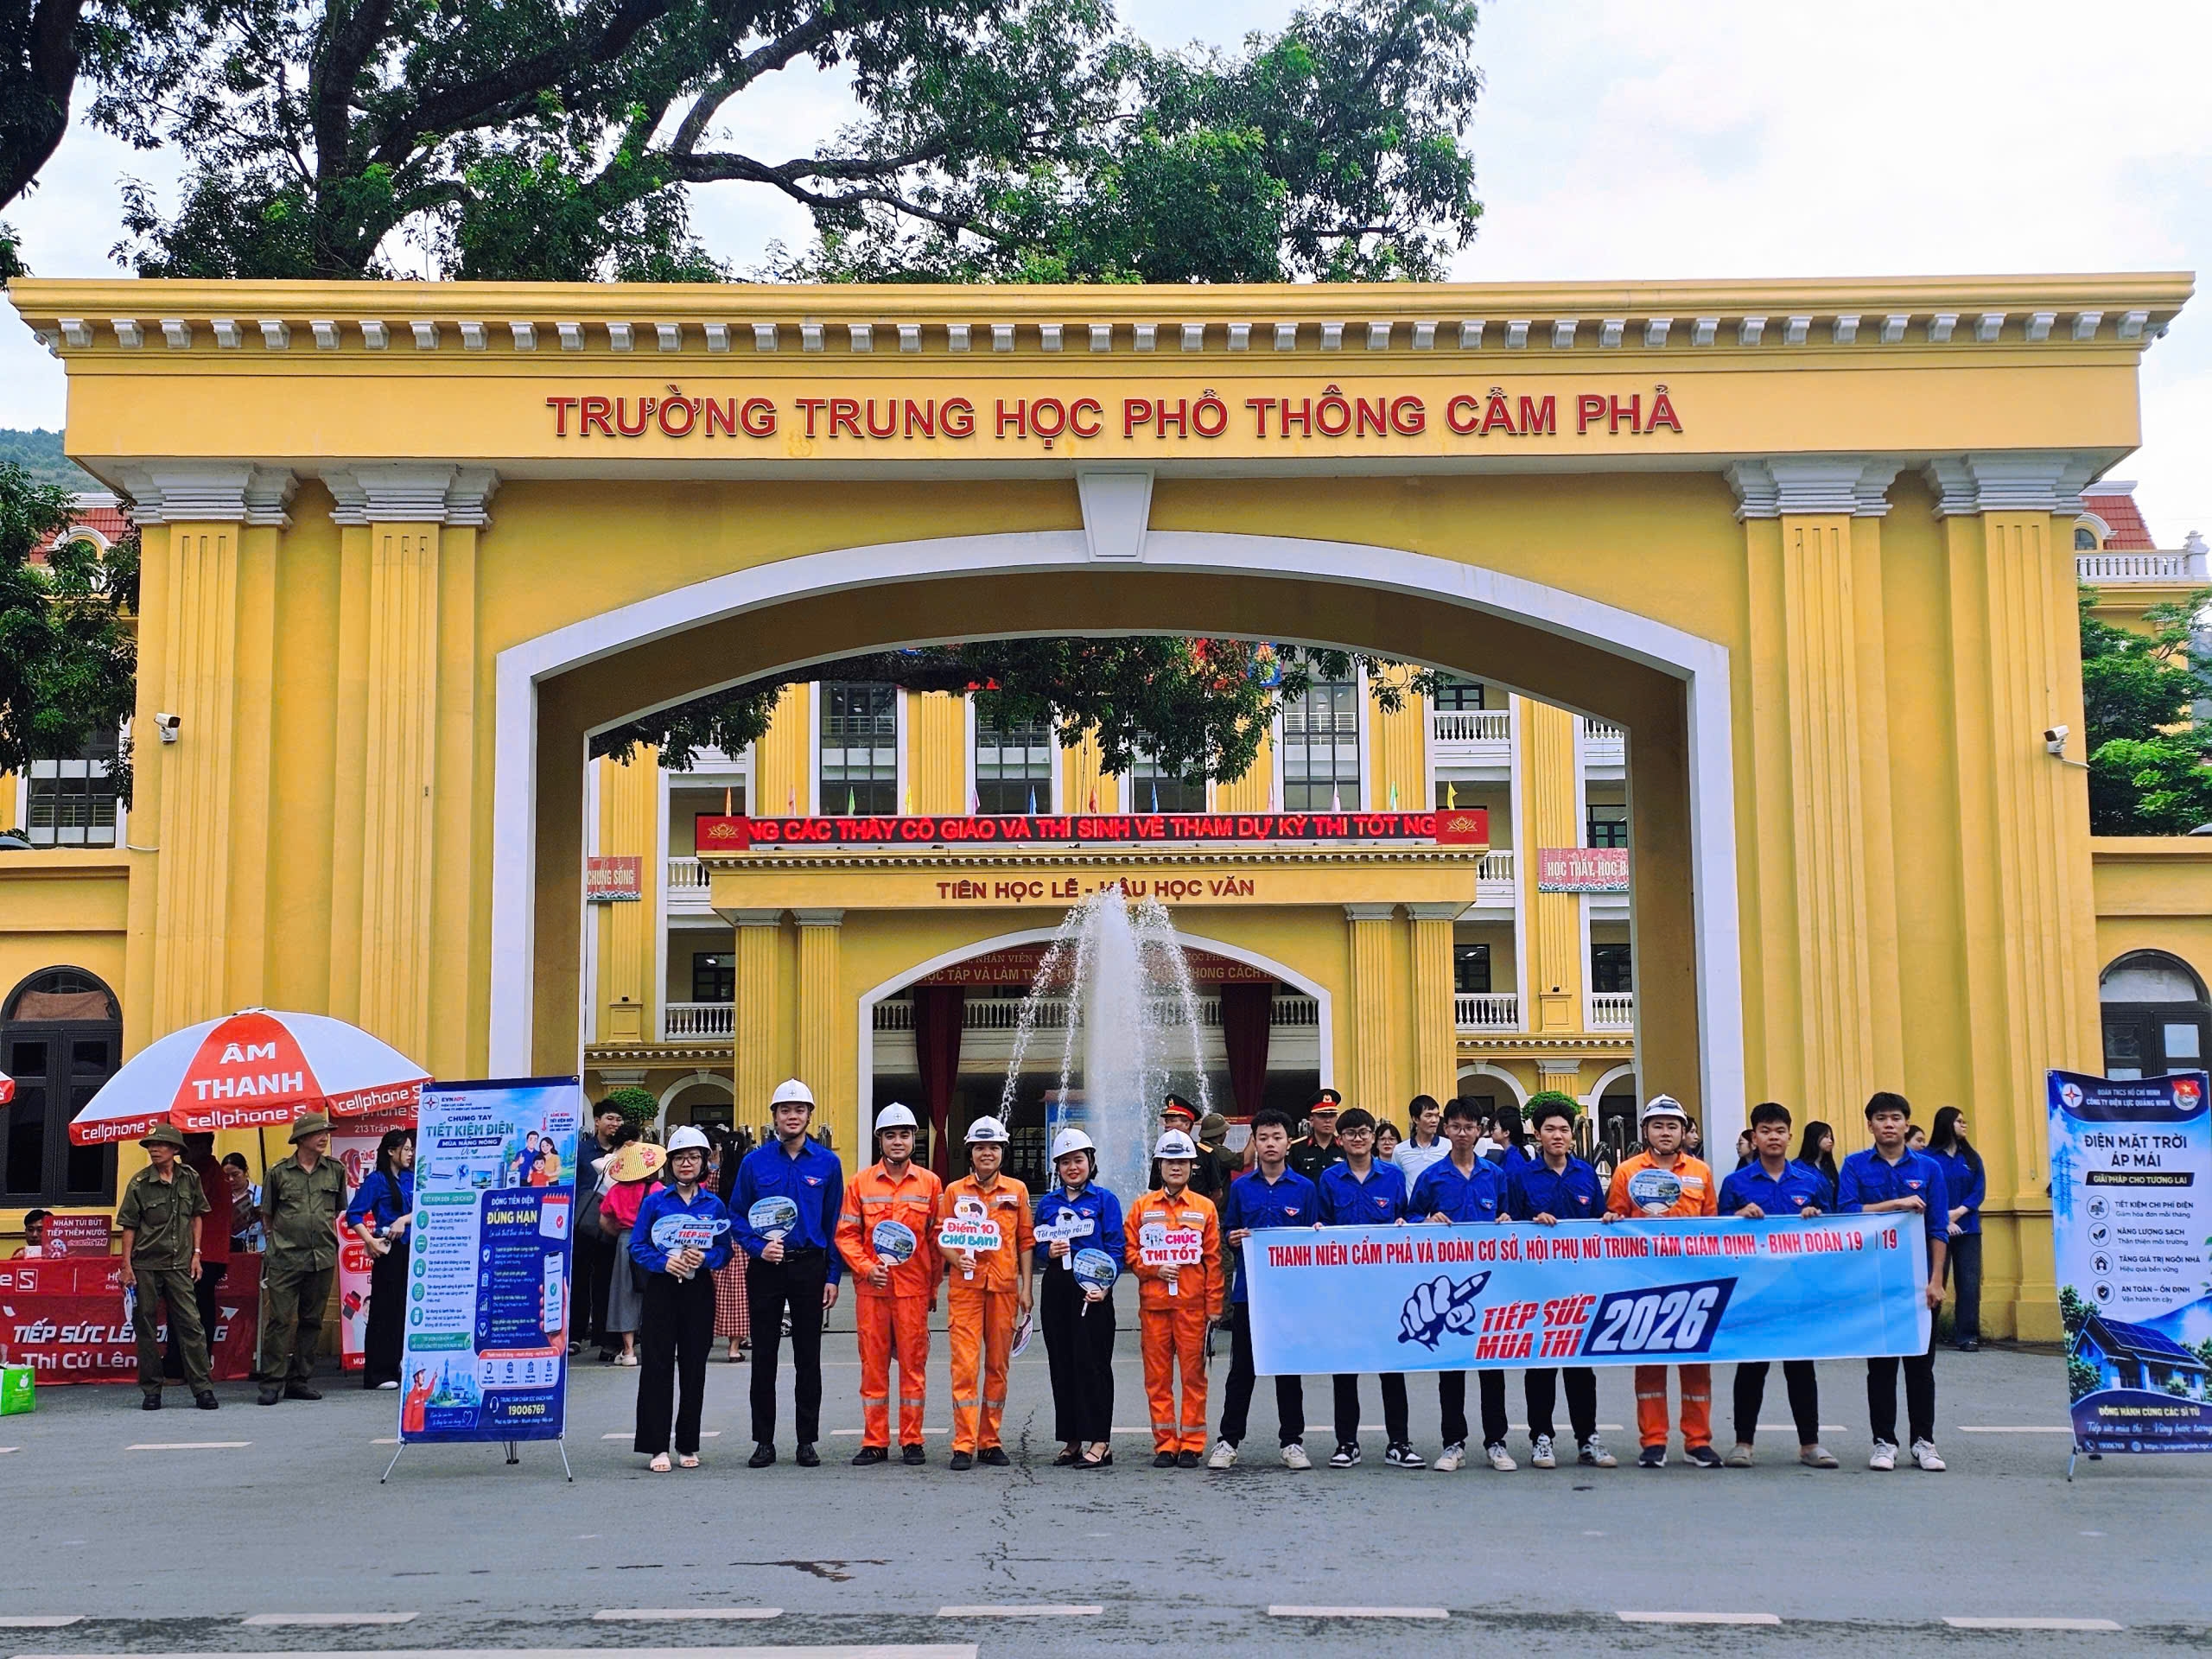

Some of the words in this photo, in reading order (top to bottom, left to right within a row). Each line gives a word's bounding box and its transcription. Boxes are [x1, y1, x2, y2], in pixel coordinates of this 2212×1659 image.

[546, 384, 778, 436] TRƯỜNG
[795, 397, 976, 437] TRUNG
[995, 397, 1103, 448] HỌC
[1123, 388, 1229, 436] PHỔ
[1246, 385, 1427, 436] THÔNG
[1445, 386, 1556, 435] CẨM
[1577, 385, 1683, 434] PHẢ
[784, 817, 831, 841] CÁC
[836, 817, 896, 841] THẦY
[901, 817, 935, 841] CÔ
[941, 817, 995, 839] GIÁO
[1001, 817, 1032, 838] VÀ
[1037, 817, 1071, 838] THÍ
[1077, 818, 1129, 839] SINH
[1135, 816, 1166, 838] VỀ
[1170, 818, 1231, 837] THAM
[1239, 817, 1272, 839] DỰ
[1313, 817, 1347, 836] THI
[613, 864, 633, 885] SỐNG
[1547, 861, 1567, 880] HỌC
[1598, 861, 1618, 880] HỌC
[995, 880, 1044, 902] HỌC
[1052, 878, 1078, 898] LỄ
[1154, 880, 1202, 900] HỌC
[1210, 876, 1254, 896] VĂN
[925, 969, 944, 984] ỌC
[947, 966, 970, 984] TẬP
[974, 966, 992, 981] VÀ
[994, 965, 1019, 981] LÀM
[1188, 967, 1224, 979] HONG
[1228, 964, 1260, 979] CÁCH
[219, 1042, 276, 1064] ÂM
[192, 1071, 303, 1100] THANH
[338, 1089, 410, 1111] cellphone
[187, 1109, 289, 1129] cellphone
[82, 1122, 145, 1141] cellphone
[426, 1122, 452, 1137] TIẾT
[454, 1122, 483, 1138] KIỆM
[486, 1120, 514, 1136] ĐIỆN
[2084, 1132, 2114, 1151] ĐIỆN
[2119, 1133, 2148, 1151] MẶT
[2152, 1133, 2187, 1148] TRỜI
[2111, 1151, 2129, 1166] ÁP
[2133, 1151, 2161, 1166] MÁI
[2108, 1174, 2127, 1183] PHÁP
[491, 1196, 507, 1205] ĐÓNG
[508, 1193, 519, 1205] TIỀN
[521, 1195, 535, 1206] ĐIỆN
[2176, 1200, 2193, 1209] ĐIỆN
[54, 1217, 73, 1227] NHẬN
[75, 1217, 86, 1226] TÚI
[88, 1217, 103, 1226] BÚT
[486, 1207, 514, 1224] ĐÚNG
[516, 1210, 537, 1227] HẠN
[47, 1227, 63, 1236] TIẾP
[65, 1228, 85, 1236] THÊM
[947, 1222, 977, 1233] Điểm
[981, 1224, 994, 1234] 10
[1049, 1227, 1071, 1239] nghiệp
[1165, 1231, 1197, 1244] CHÚC
[941, 1233, 966, 1244] CHỜ
[1268, 1245, 1312, 1267] THANH
[1315, 1240, 1348, 1266] NIÊN
[1351, 1236, 1382, 1265] CẨM
[1386, 1236, 1414, 1264] PHẢ
[1417, 1238, 1434, 1263] VÀ
[1438, 1237, 1474, 1262] ĐOÀN
[1478, 1238, 1497, 1262] CƠ
[1526, 1235, 1548, 1264] HỘI
[1552, 1238, 1579, 1263] PHỤ
[1582, 1234, 1601, 1259] NỮ
[1604, 1236, 1648, 1258] TRUNG
[1652, 1232, 1681, 1257] TÂM
[1685, 1232, 1720, 1256] GIÁM
[1723, 1235, 1756, 1260] ĐỊNH
[1768, 1233, 1802, 1254] BINH
[1804, 1228, 1843, 1252] ĐOÀN
[1846, 1230, 1863, 1251] 19
[1882, 1229, 1897, 1249] 19
[1145, 1249, 1168, 1261] THI
[1170, 1244, 1198, 1260] TỐT
[2172, 1286, 2190, 1294] ĐỊNH
[1482, 1300, 1540, 1332] TIẾP
[1542, 1294, 1597, 1327] SỨC
[1591, 1286, 1719, 1351] 2026
[14, 1318, 57, 1343] TIẾP
[59, 1320, 105, 1343] SỨC
[1475, 1332, 1534, 1360] MÙA
[1539, 1328, 1585, 1357] THI
[21, 1353, 57, 1369] Thi
[63, 1351, 92, 1369] Cử
[97, 1351, 137, 1368] Lên
[508, 1404, 545, 1415] 19006769
[2164, 1406, 2179, 1416] CÁC
